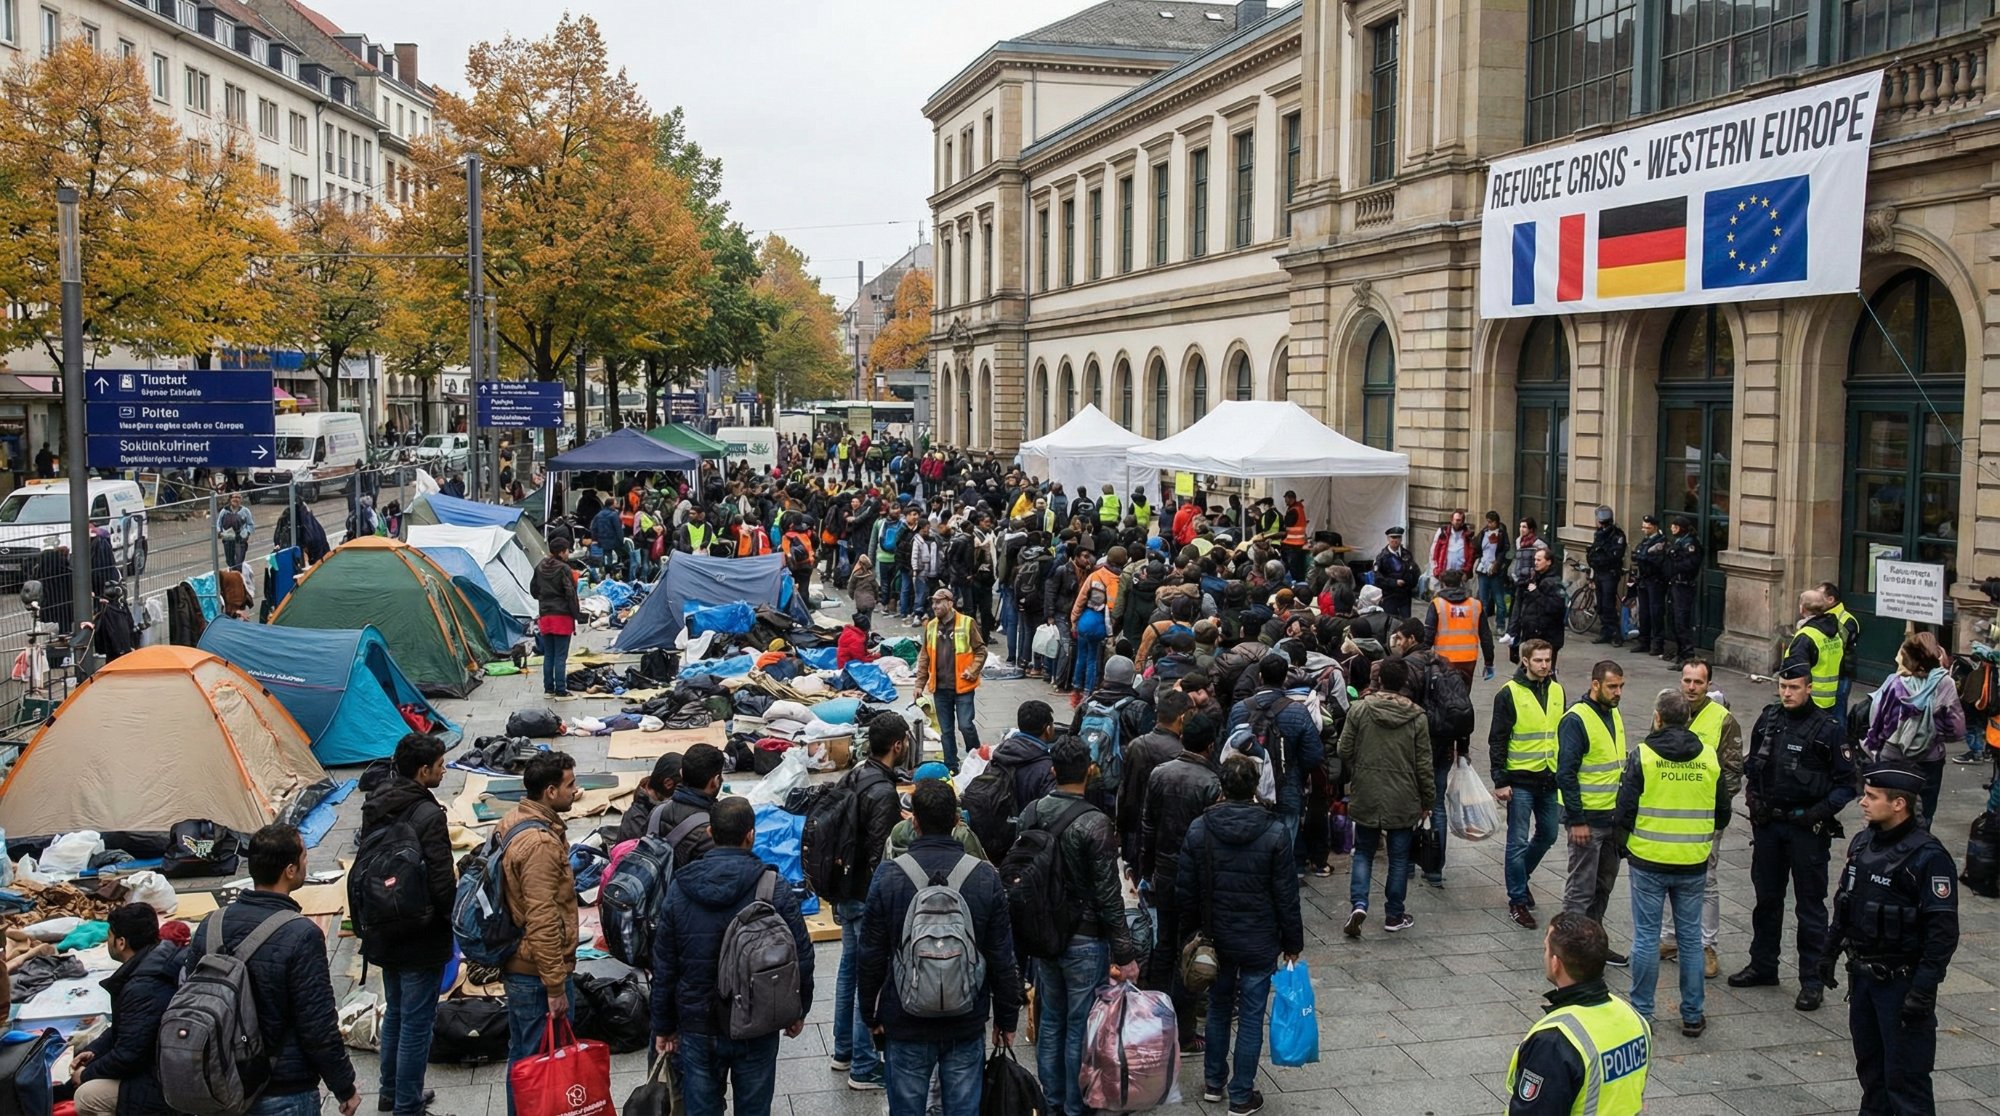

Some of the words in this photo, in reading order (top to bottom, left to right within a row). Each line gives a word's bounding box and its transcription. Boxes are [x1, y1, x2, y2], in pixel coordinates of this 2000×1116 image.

[1490, 160, 1565, 210] REFUGEE
[1567, 145, 1629, 196] CRISIS
[1647, 117, 1756, 181] WESTERN
[1759, 91, 1870, 160] EUROPE
[1603, 1038, 1647, 1080] POLICE
